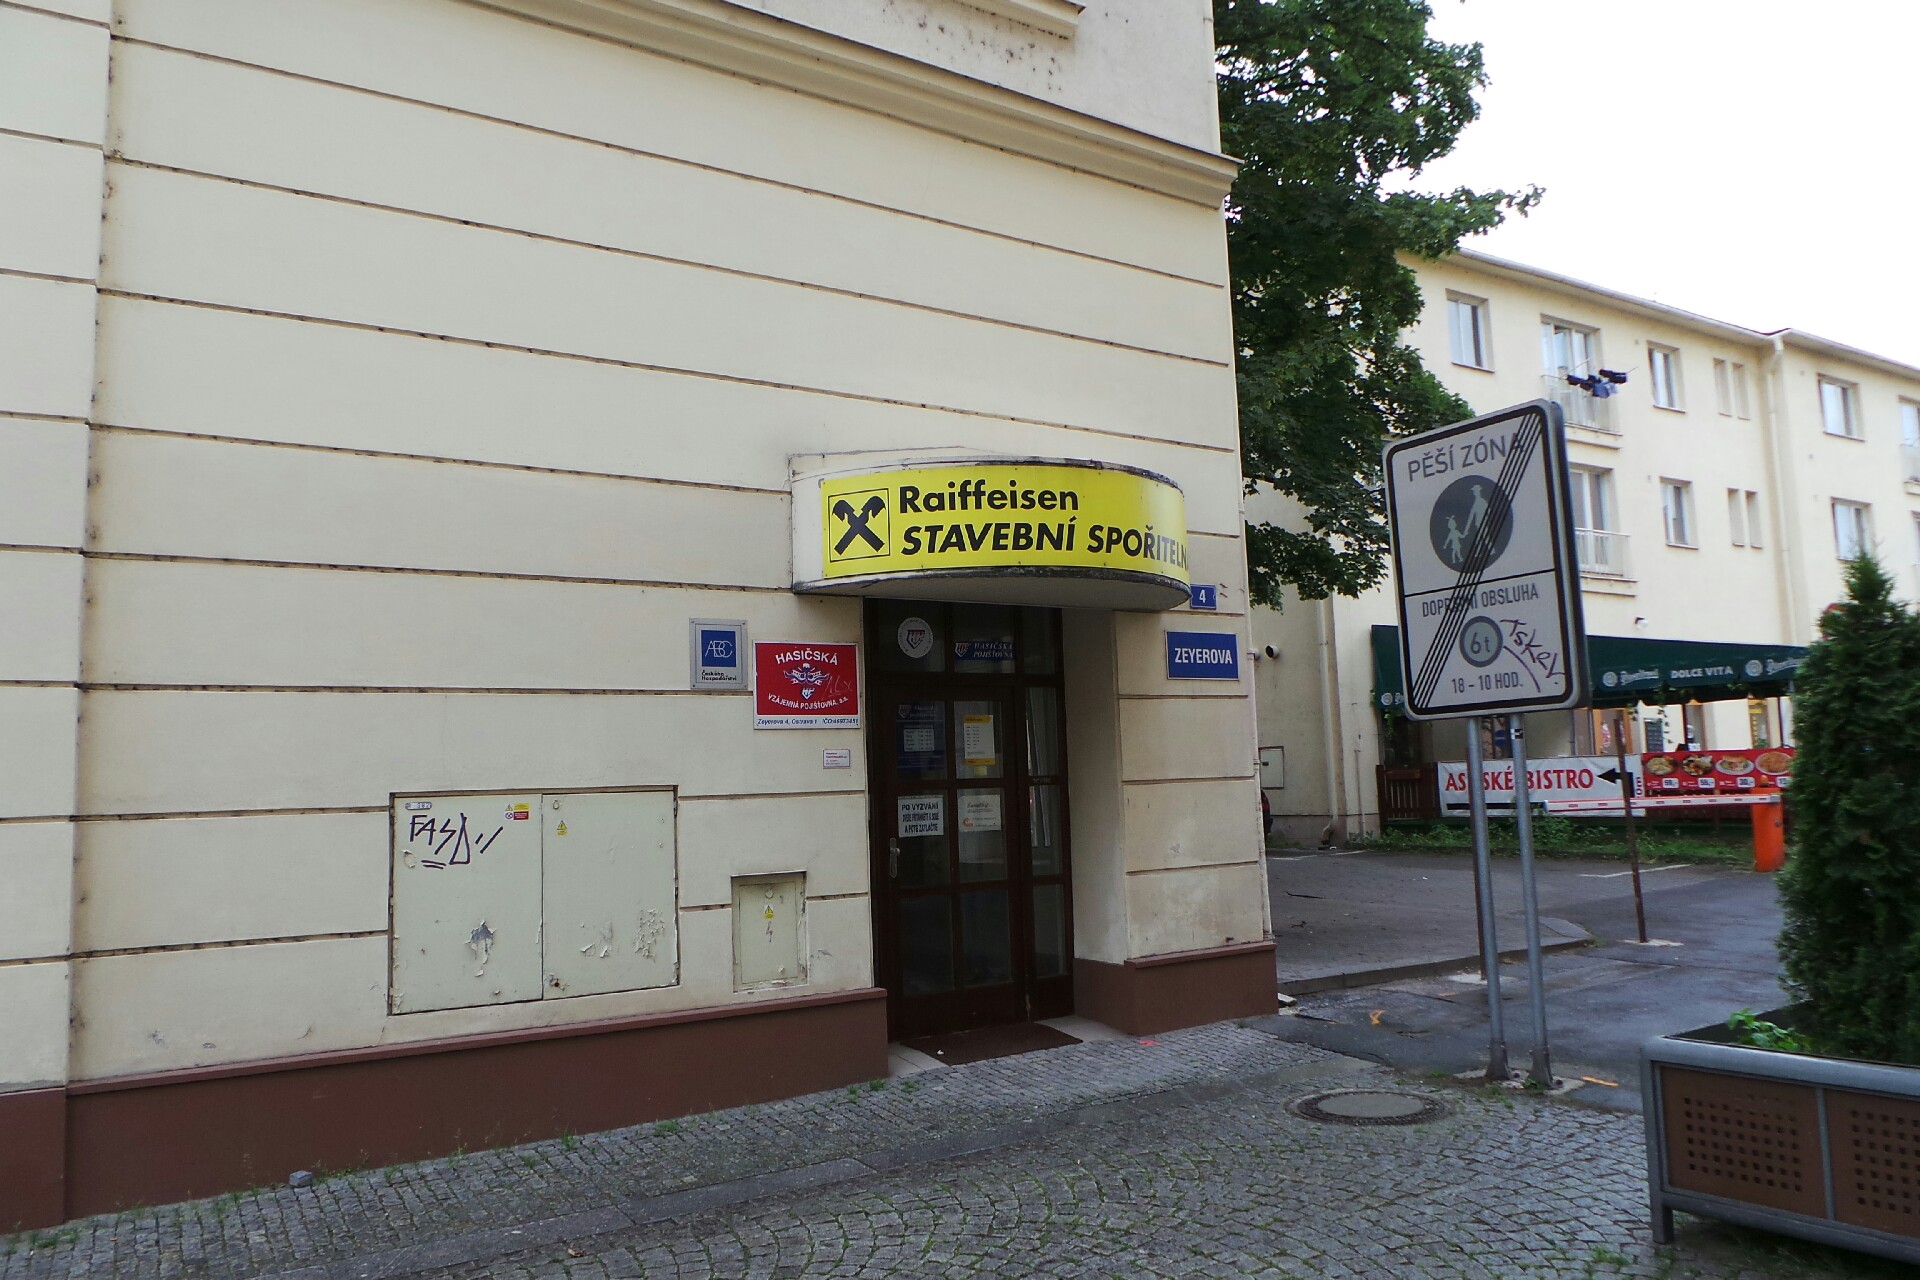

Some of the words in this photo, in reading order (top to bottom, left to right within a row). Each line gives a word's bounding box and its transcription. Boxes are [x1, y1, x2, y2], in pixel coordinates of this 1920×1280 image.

[1407, 445, 1455, 481] PĚŠÍ
[899, 479, 1079, 514] Raiffeisen
[901, 516, 1077, 555] STAVEBNÍ
[1199, 589, 1207, 604] 4
[1481, 583, 1539, 607] OBSLUHA
[704, 640, 733, 658] ABC
[775, 648, 838, 666] HASIČSKÁ
[1174, 647, 1233, 664] ZEYEROVA
[1452, 678, 1465, 693] 18
[1479, 674, 1492, 690] 10
[1495, 672, 1523, 688] HOD.
[1670, 669, 1703, 679] DOLCE
[1705, 666, 1734, 676] VITA
[1445, 766, 1514, 791] ASSKÉ
[1527, 768, 1594, 789] BISTRO
